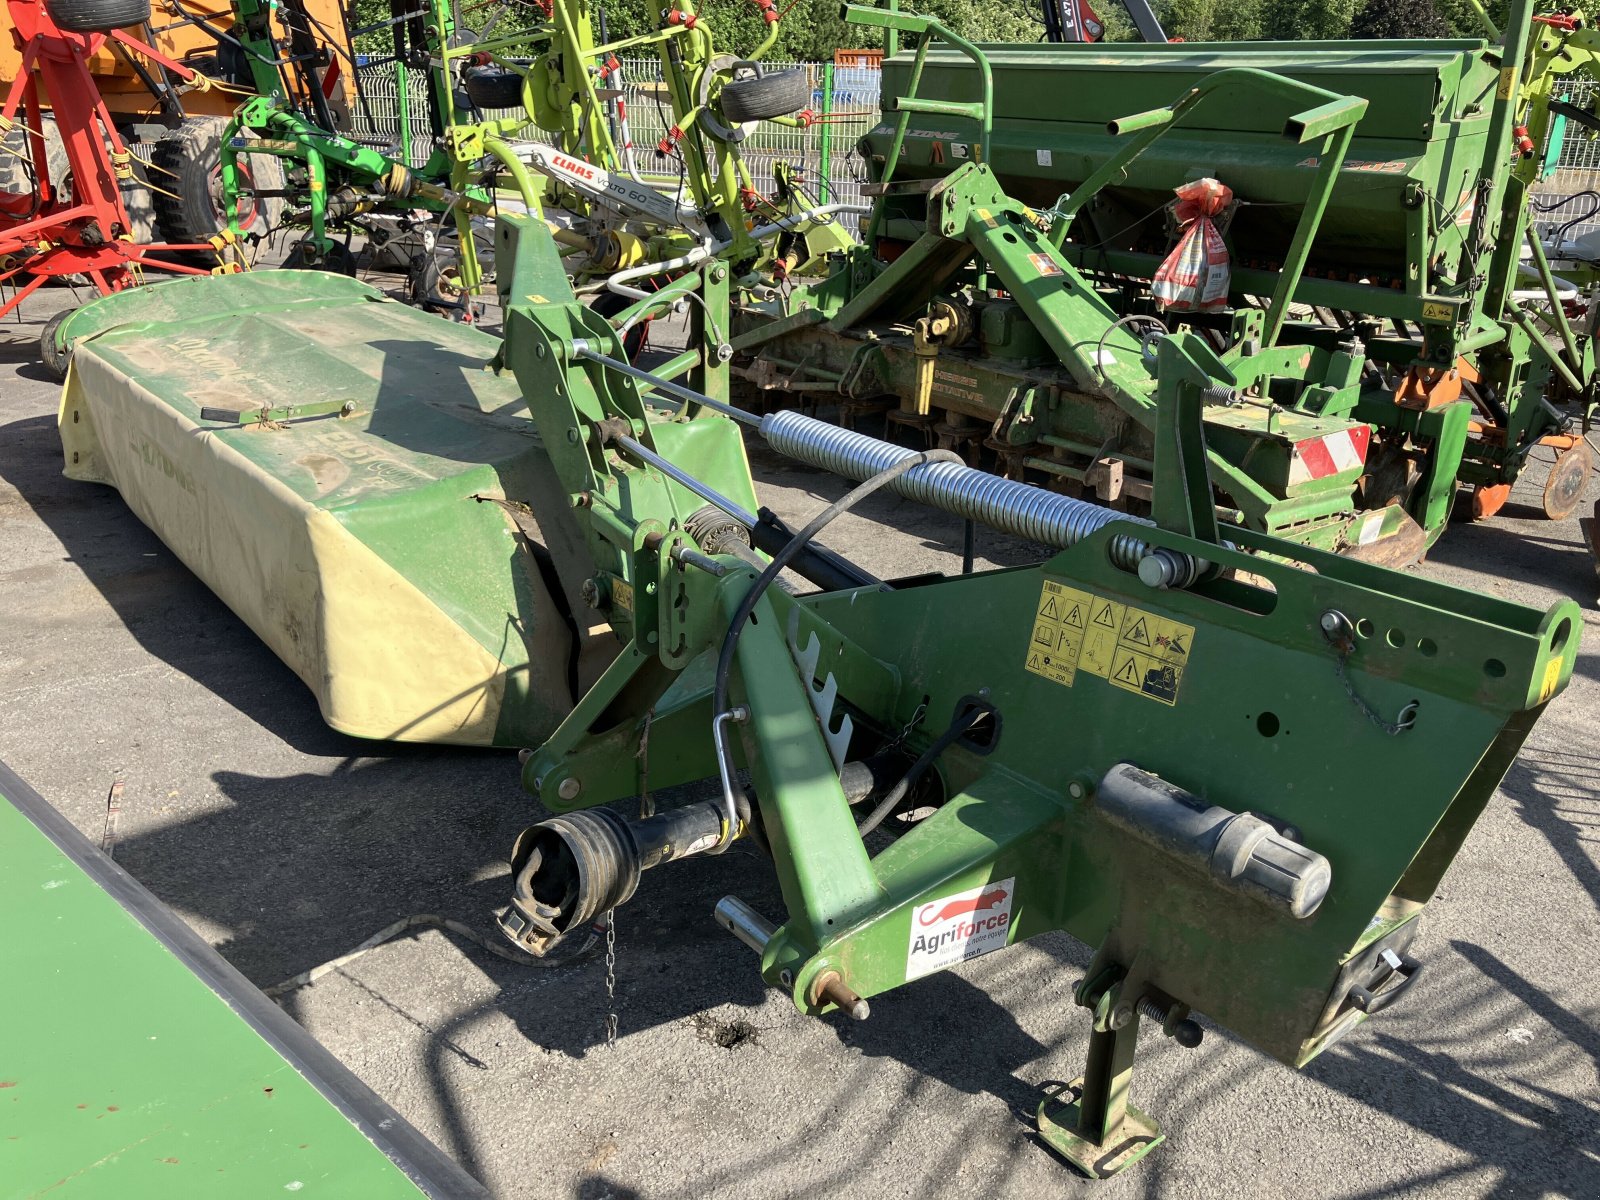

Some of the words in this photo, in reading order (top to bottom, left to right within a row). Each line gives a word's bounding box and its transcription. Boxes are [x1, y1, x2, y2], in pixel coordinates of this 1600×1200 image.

[1063, 0, 1072, 16] 47
[1066, 19, 1074, 28] E
[552, 155, 595, 180] CLAAS
[597, 176, 626, 195] VOLTO
[628, 190, 648, 204] 60
[911, 912, 1009, 955] Agriforce
